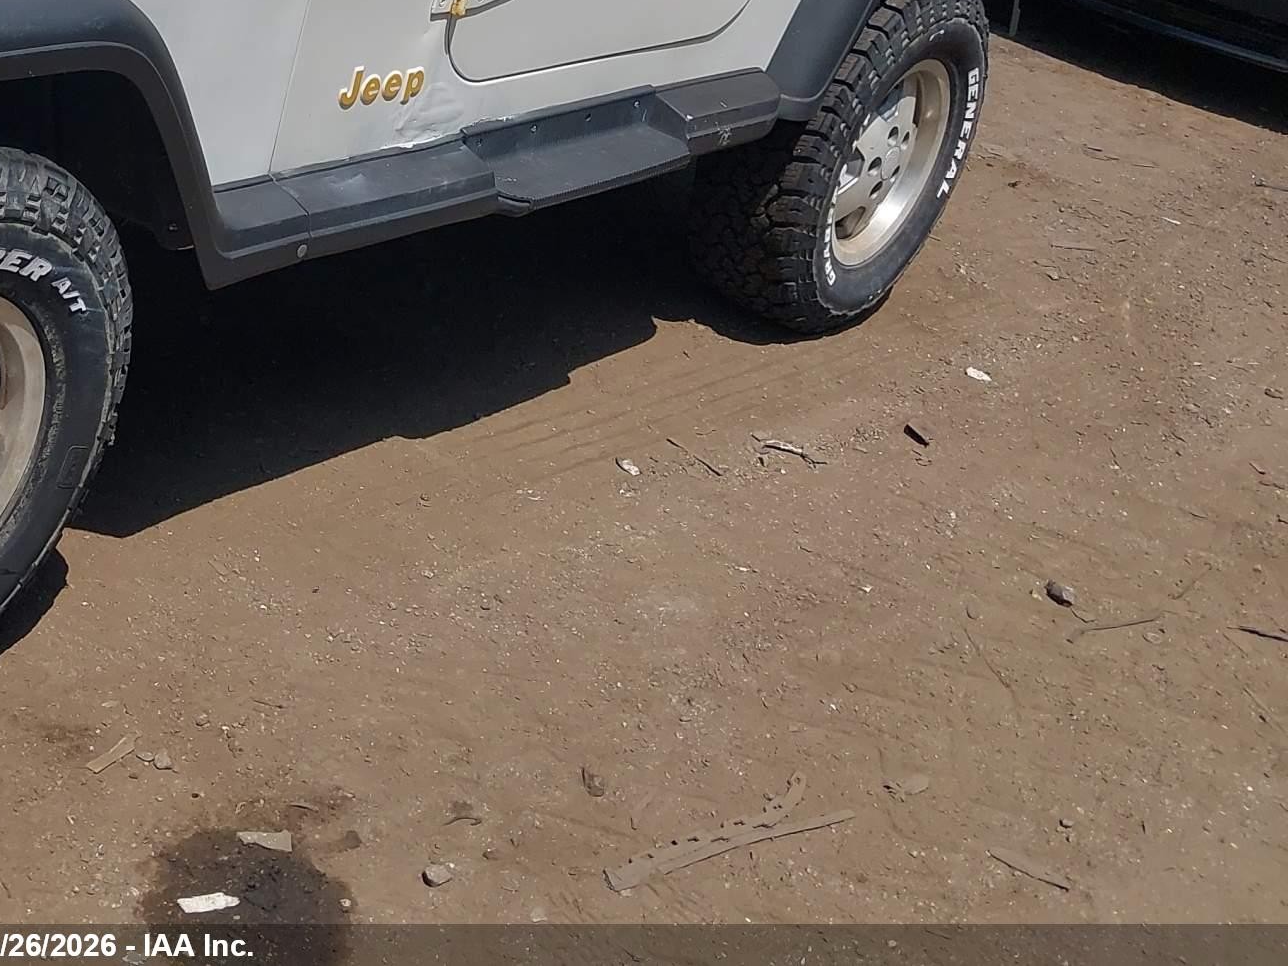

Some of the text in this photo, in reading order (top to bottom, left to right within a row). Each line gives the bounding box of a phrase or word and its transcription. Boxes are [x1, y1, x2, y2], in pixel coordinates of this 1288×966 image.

[337, 65, 425, 111] Jeep
[937, 67, 979, 199] GENERAL
[51, 276, 88, 314] A/T
